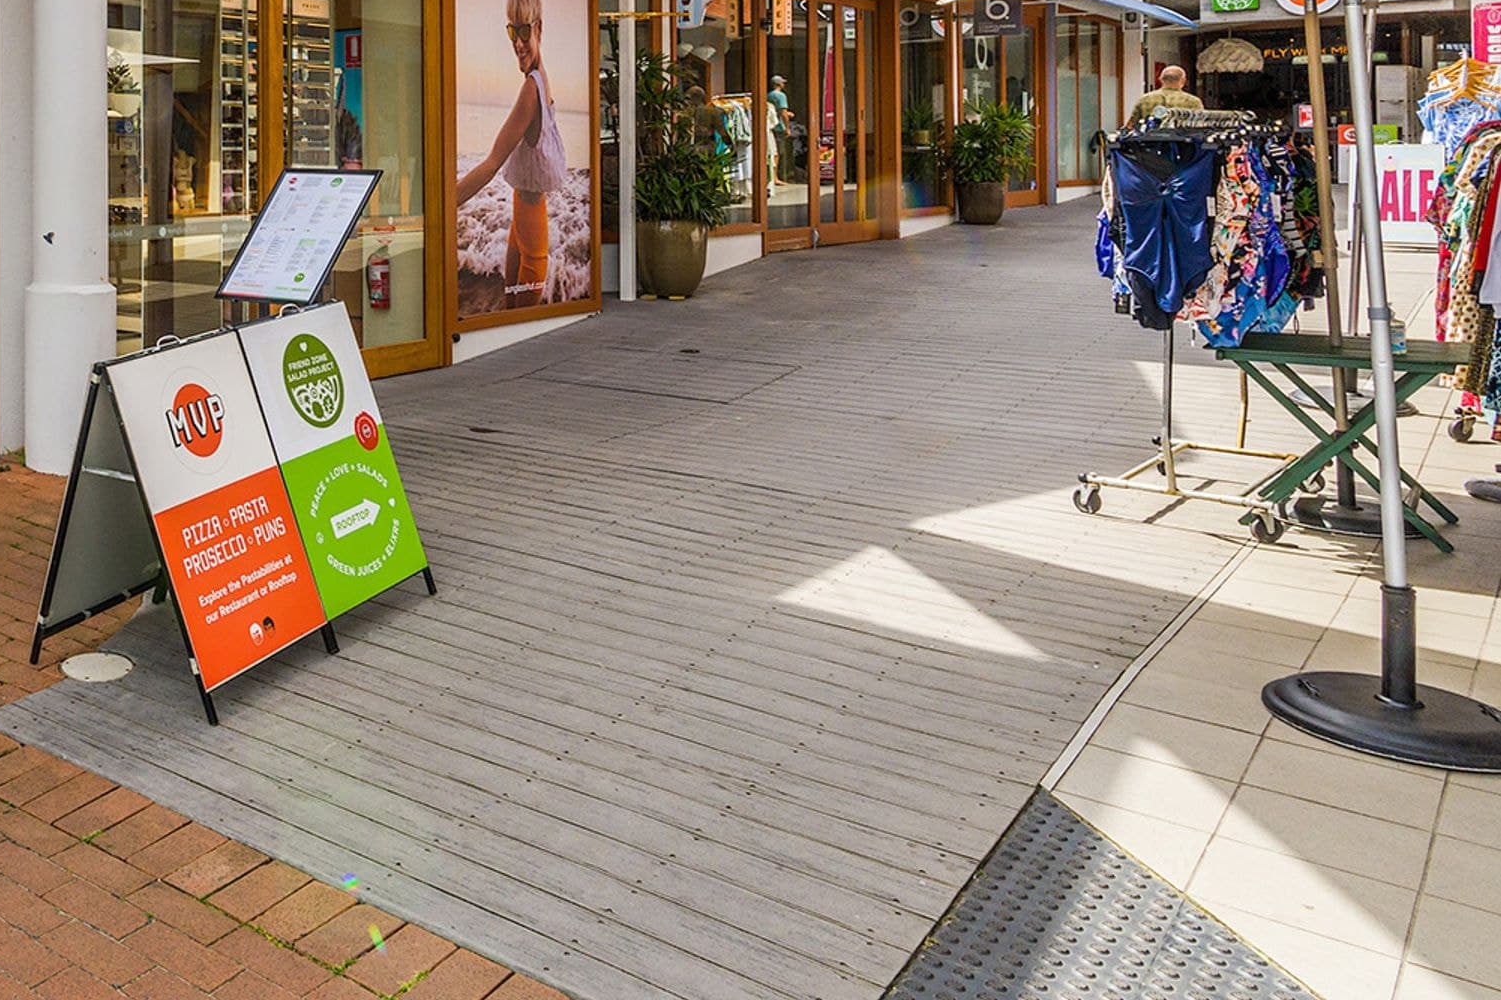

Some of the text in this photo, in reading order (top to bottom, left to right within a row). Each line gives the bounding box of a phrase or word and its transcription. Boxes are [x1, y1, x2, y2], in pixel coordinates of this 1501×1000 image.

[1263, 49, 1288, 58] FLY
[1380, 169, 1434, 222] ALE
[166, 394, 225, 447] MVP
[310, 463, 388, 518] PEACE LOVE SALADS
[182, 495, 270, 549] PIZZA PASTA
[183, 516, 286, 579] PROSECCO PUNS
[198, 587, 228, 607] Explore
[227, 580, 242, 592] the
[283, 554, 293, 565] at
[327, 554, 356, 577] GREEN
[205, 571, 298, 624] our Restaurant or Rooftop
